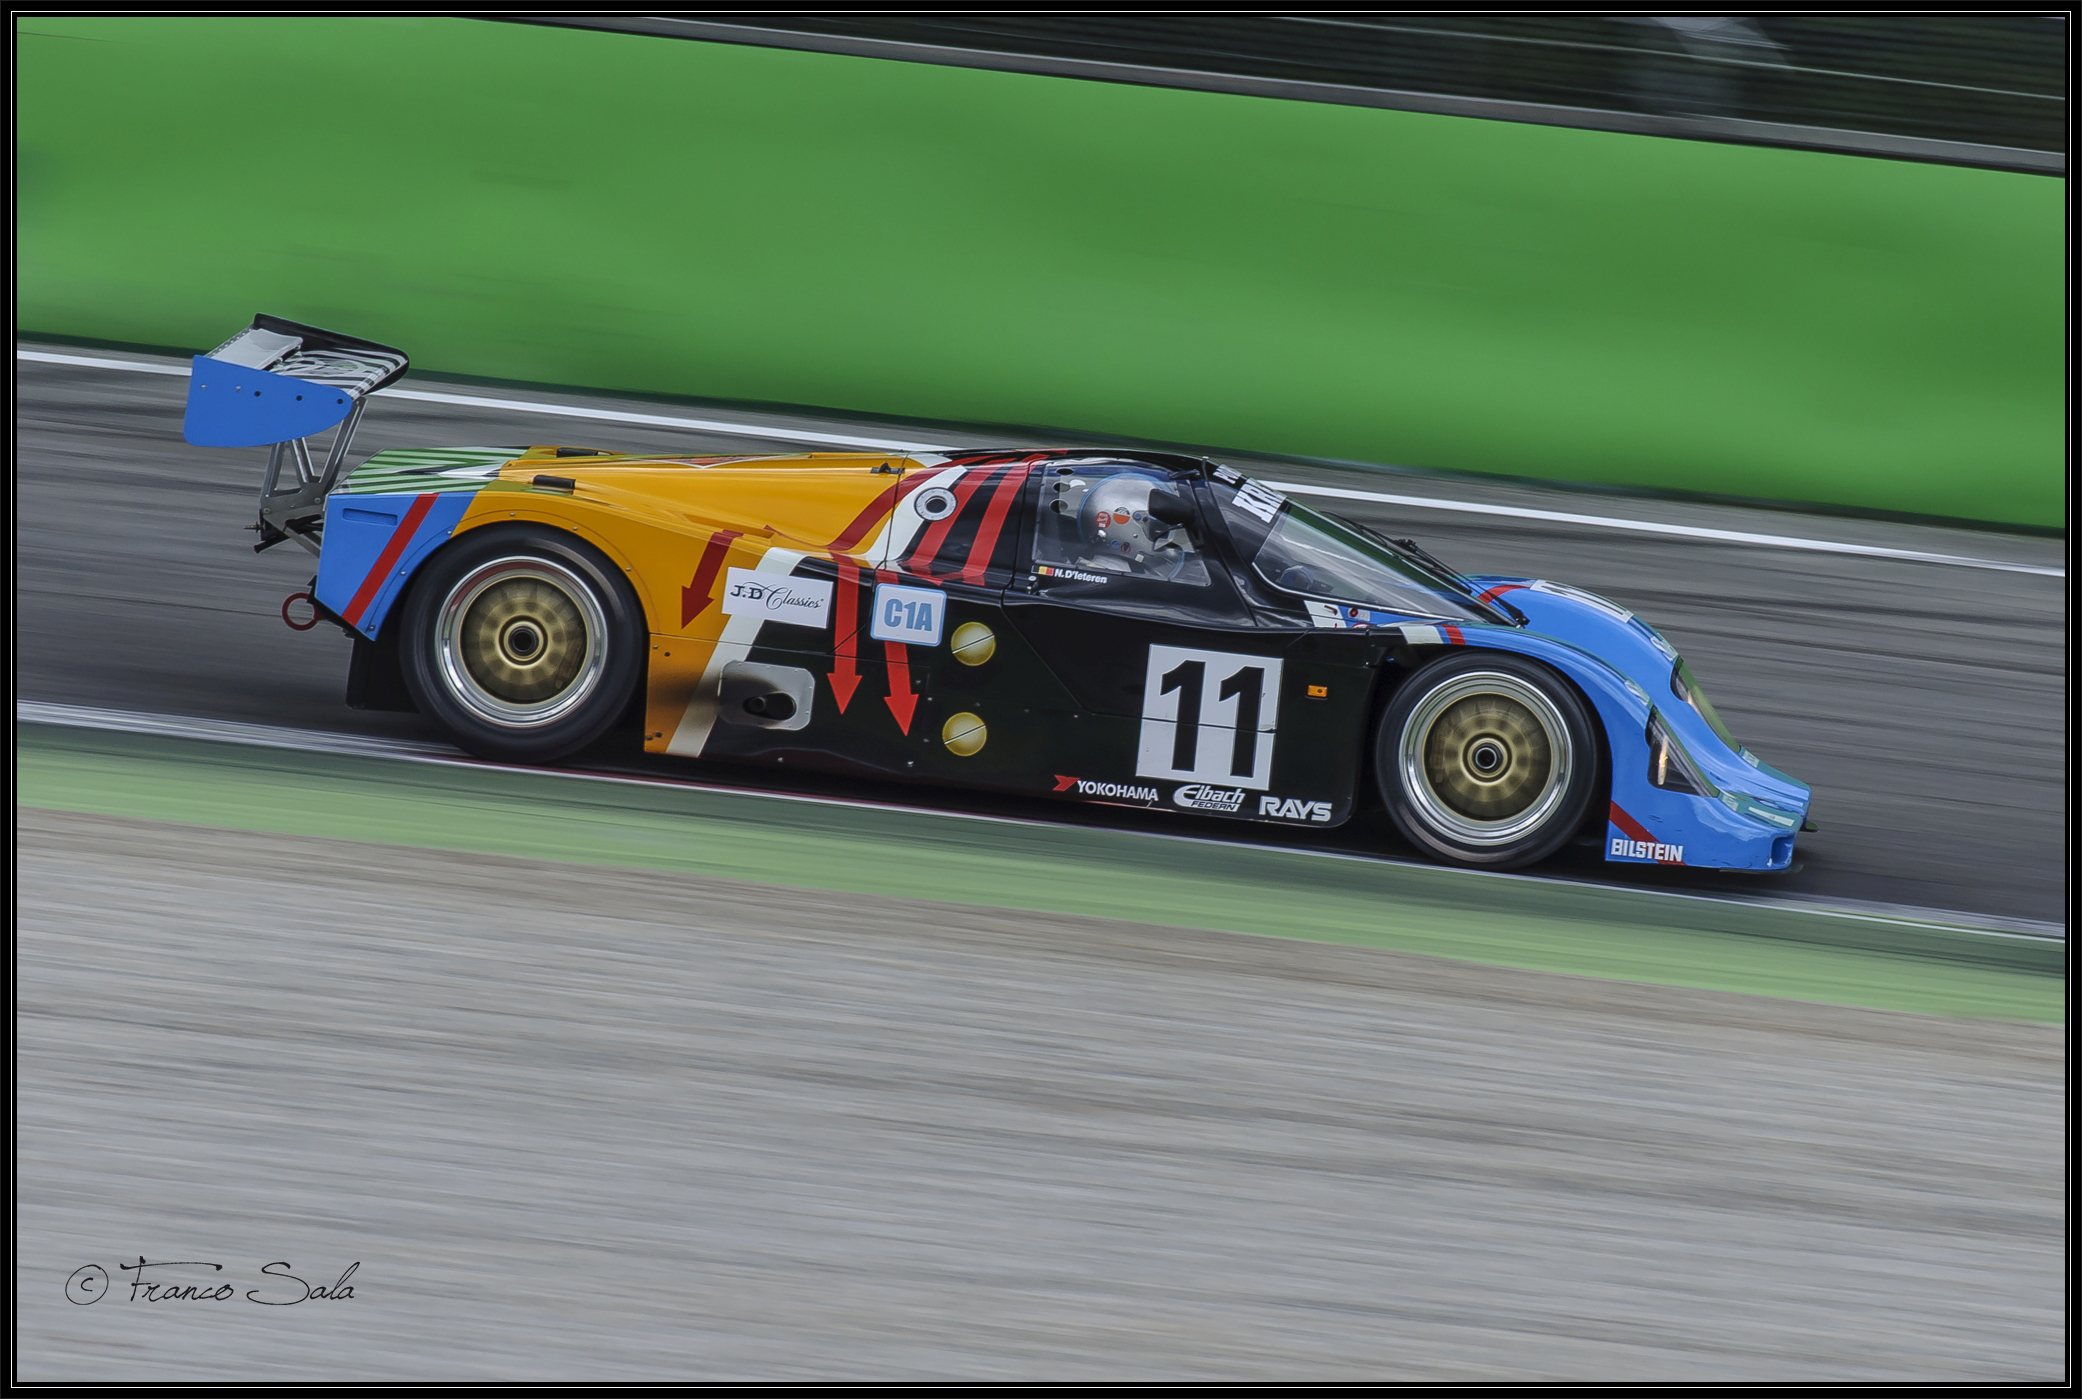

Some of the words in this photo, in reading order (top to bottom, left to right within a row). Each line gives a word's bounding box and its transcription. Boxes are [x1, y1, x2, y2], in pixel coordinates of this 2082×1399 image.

[1054, 569, 1064, 577] N.
[730, 585, 763, 599] J.D
[884, 599, 932, 631] C1A
[1160, 660, 1265, 778] 11
[1077, 780, 1159, 801] YOKOHAMA
[1173, 784, 1246, 809] Eibach
[1190, 801, 1236, 811] FEDERN
[1259, 796, 1332, 822] RAYS
[1611, 838, 1684, 862] BILSTEIN
